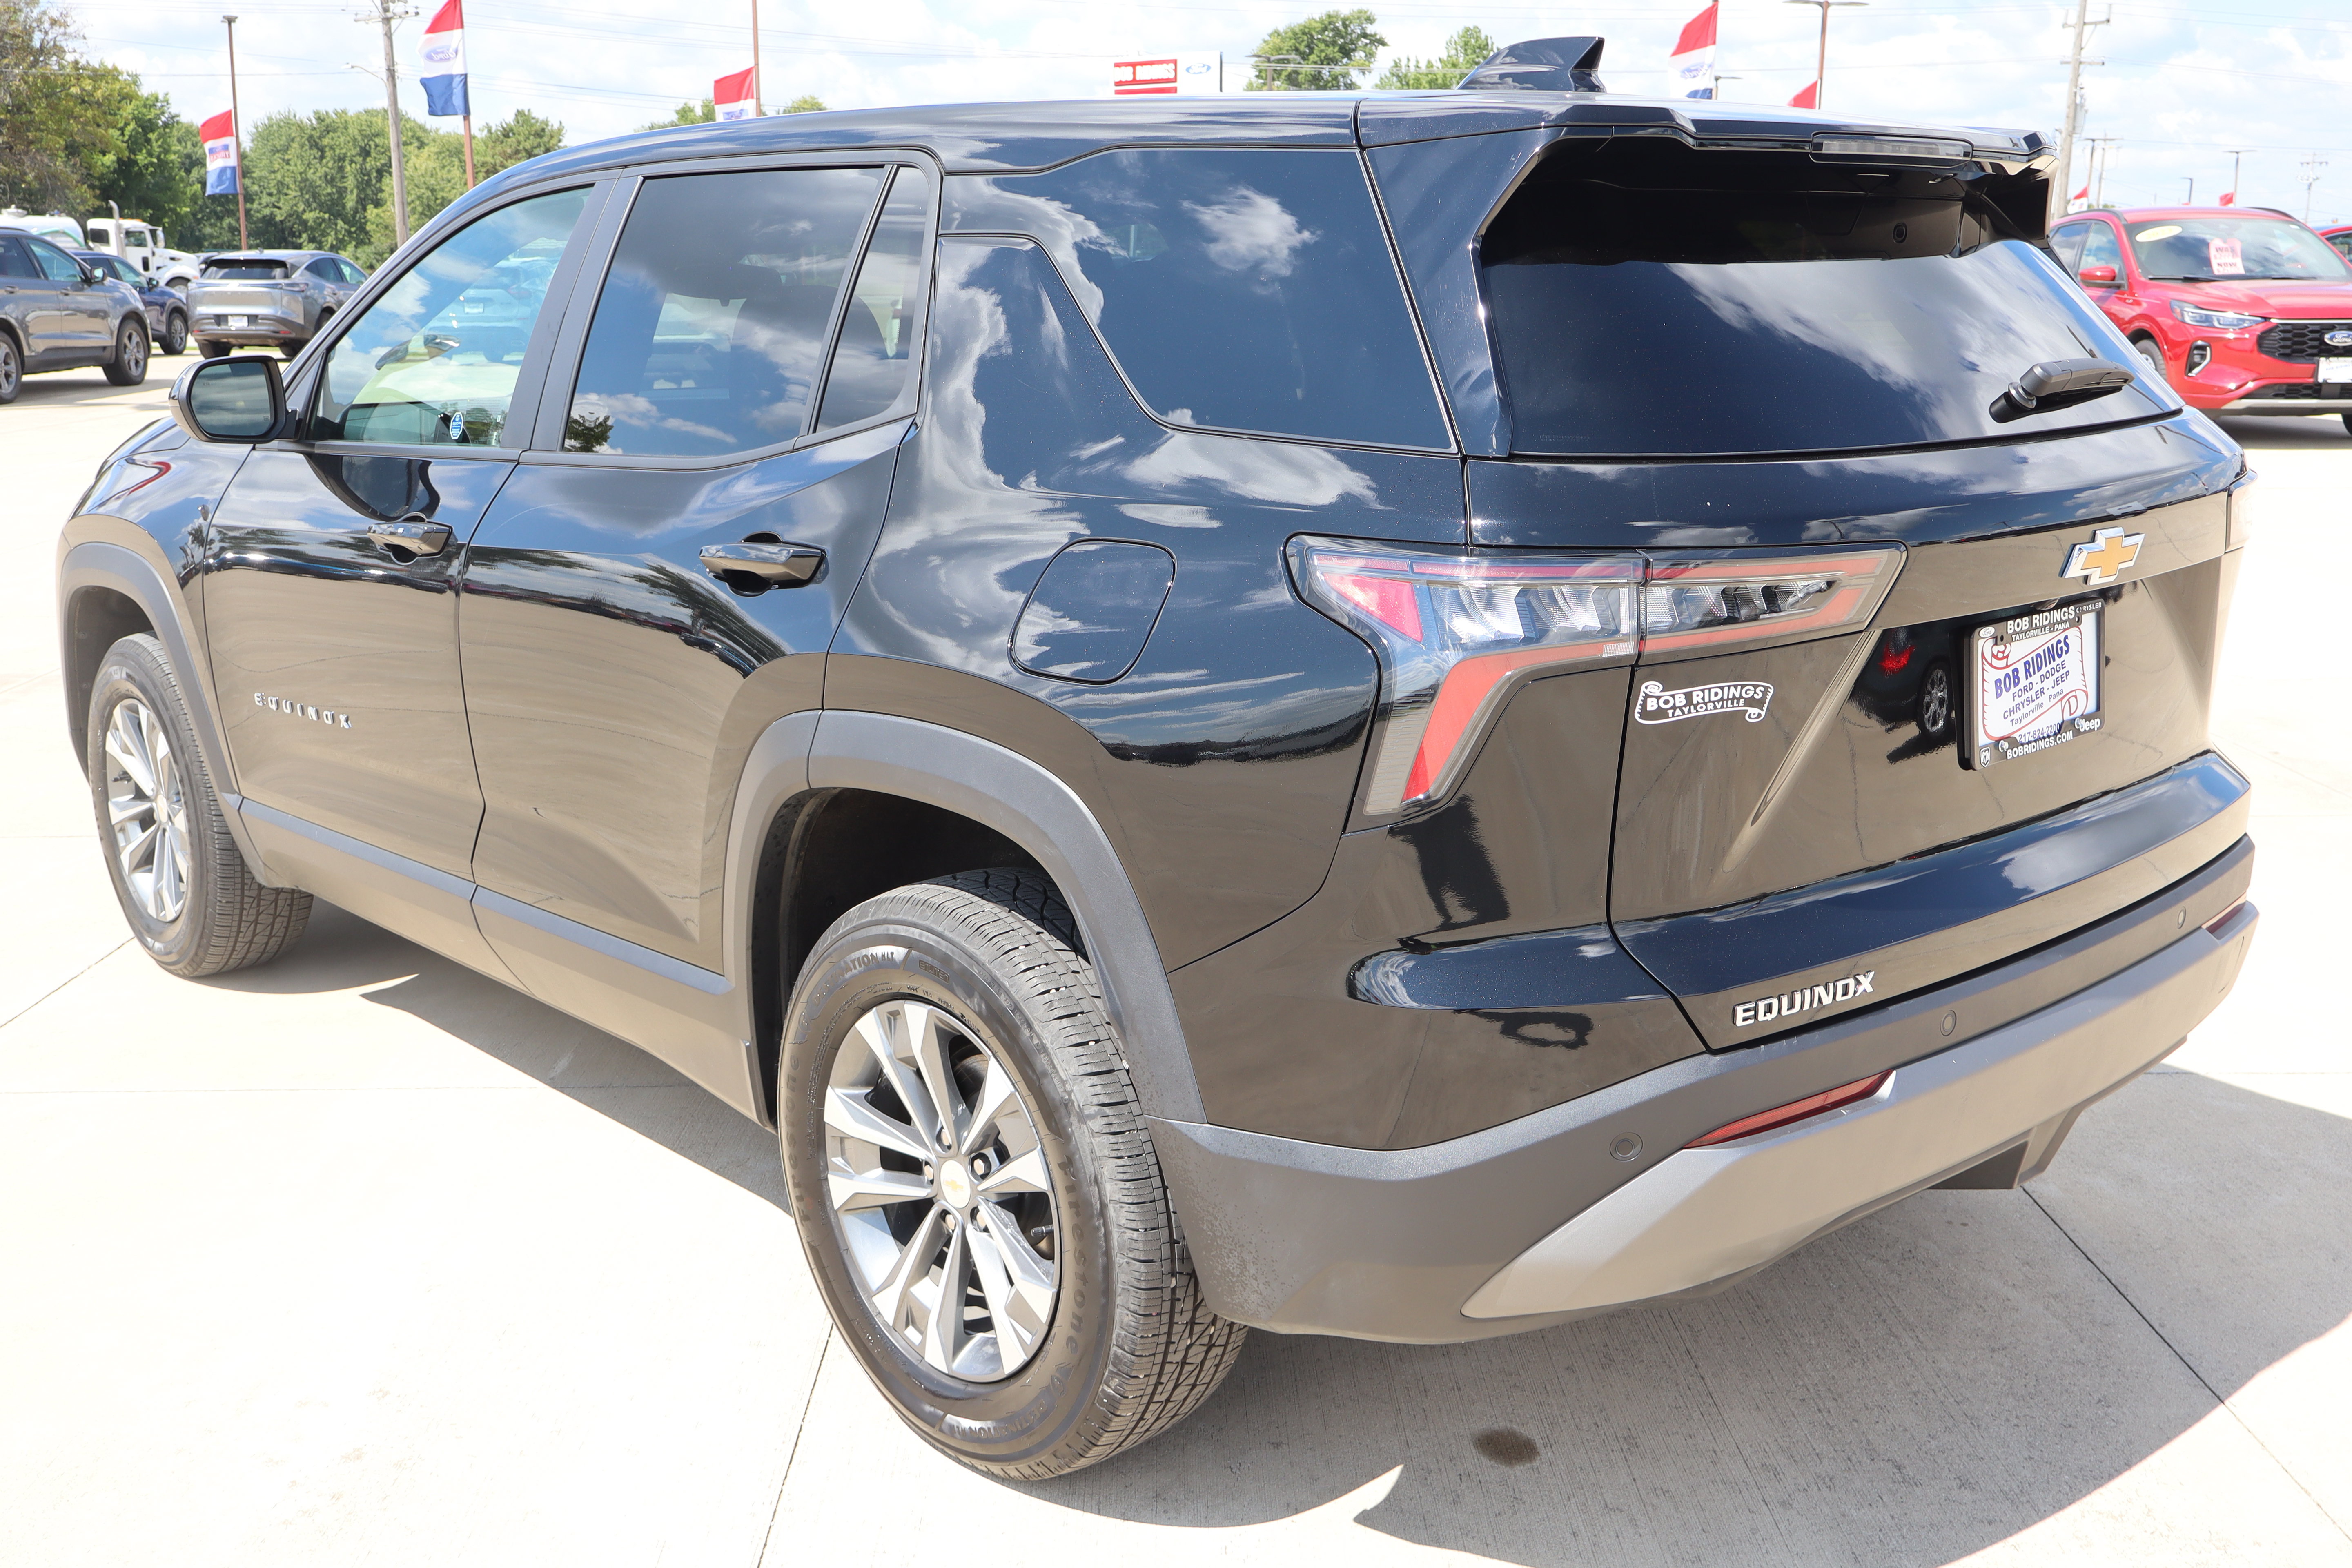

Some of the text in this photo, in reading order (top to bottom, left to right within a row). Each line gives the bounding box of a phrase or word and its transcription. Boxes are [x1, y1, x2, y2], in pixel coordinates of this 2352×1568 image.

[2007, 606, 2075, 634] BOB RIDINGS
[2076, 601, 2102, 613] CHRYSLER
[2012, 626, 2049, 641] TAYLORVILLE
[2054, 621, 2070, 631] PANA
[1994, 634, 2070, 699] BOB RIDINGS
[2012, 681, 2034, 702] FORD
[2040, 659, 2066, 683] DODGE
[1646, 686, 1764, 710] BOB RIDINGS
[1667, 699, 1745, 718] TAYLORVILLE
[2003, 686, 2045, 720] CHRYSLER
[2051, 670, 2070, 689] JEEP
[2010, 688, 2064, 727] Taylorville Pana
[254, 692, 352, 729] EQUINOX
[2080, 718, 2100, 732] Jeep
[2007, 730, 2073, 760] BOBRIDINGS.COM
[2018, 722, 2060, 744] 217-824-2200
[1732, 970, 1875, 1027] EQUINOX
